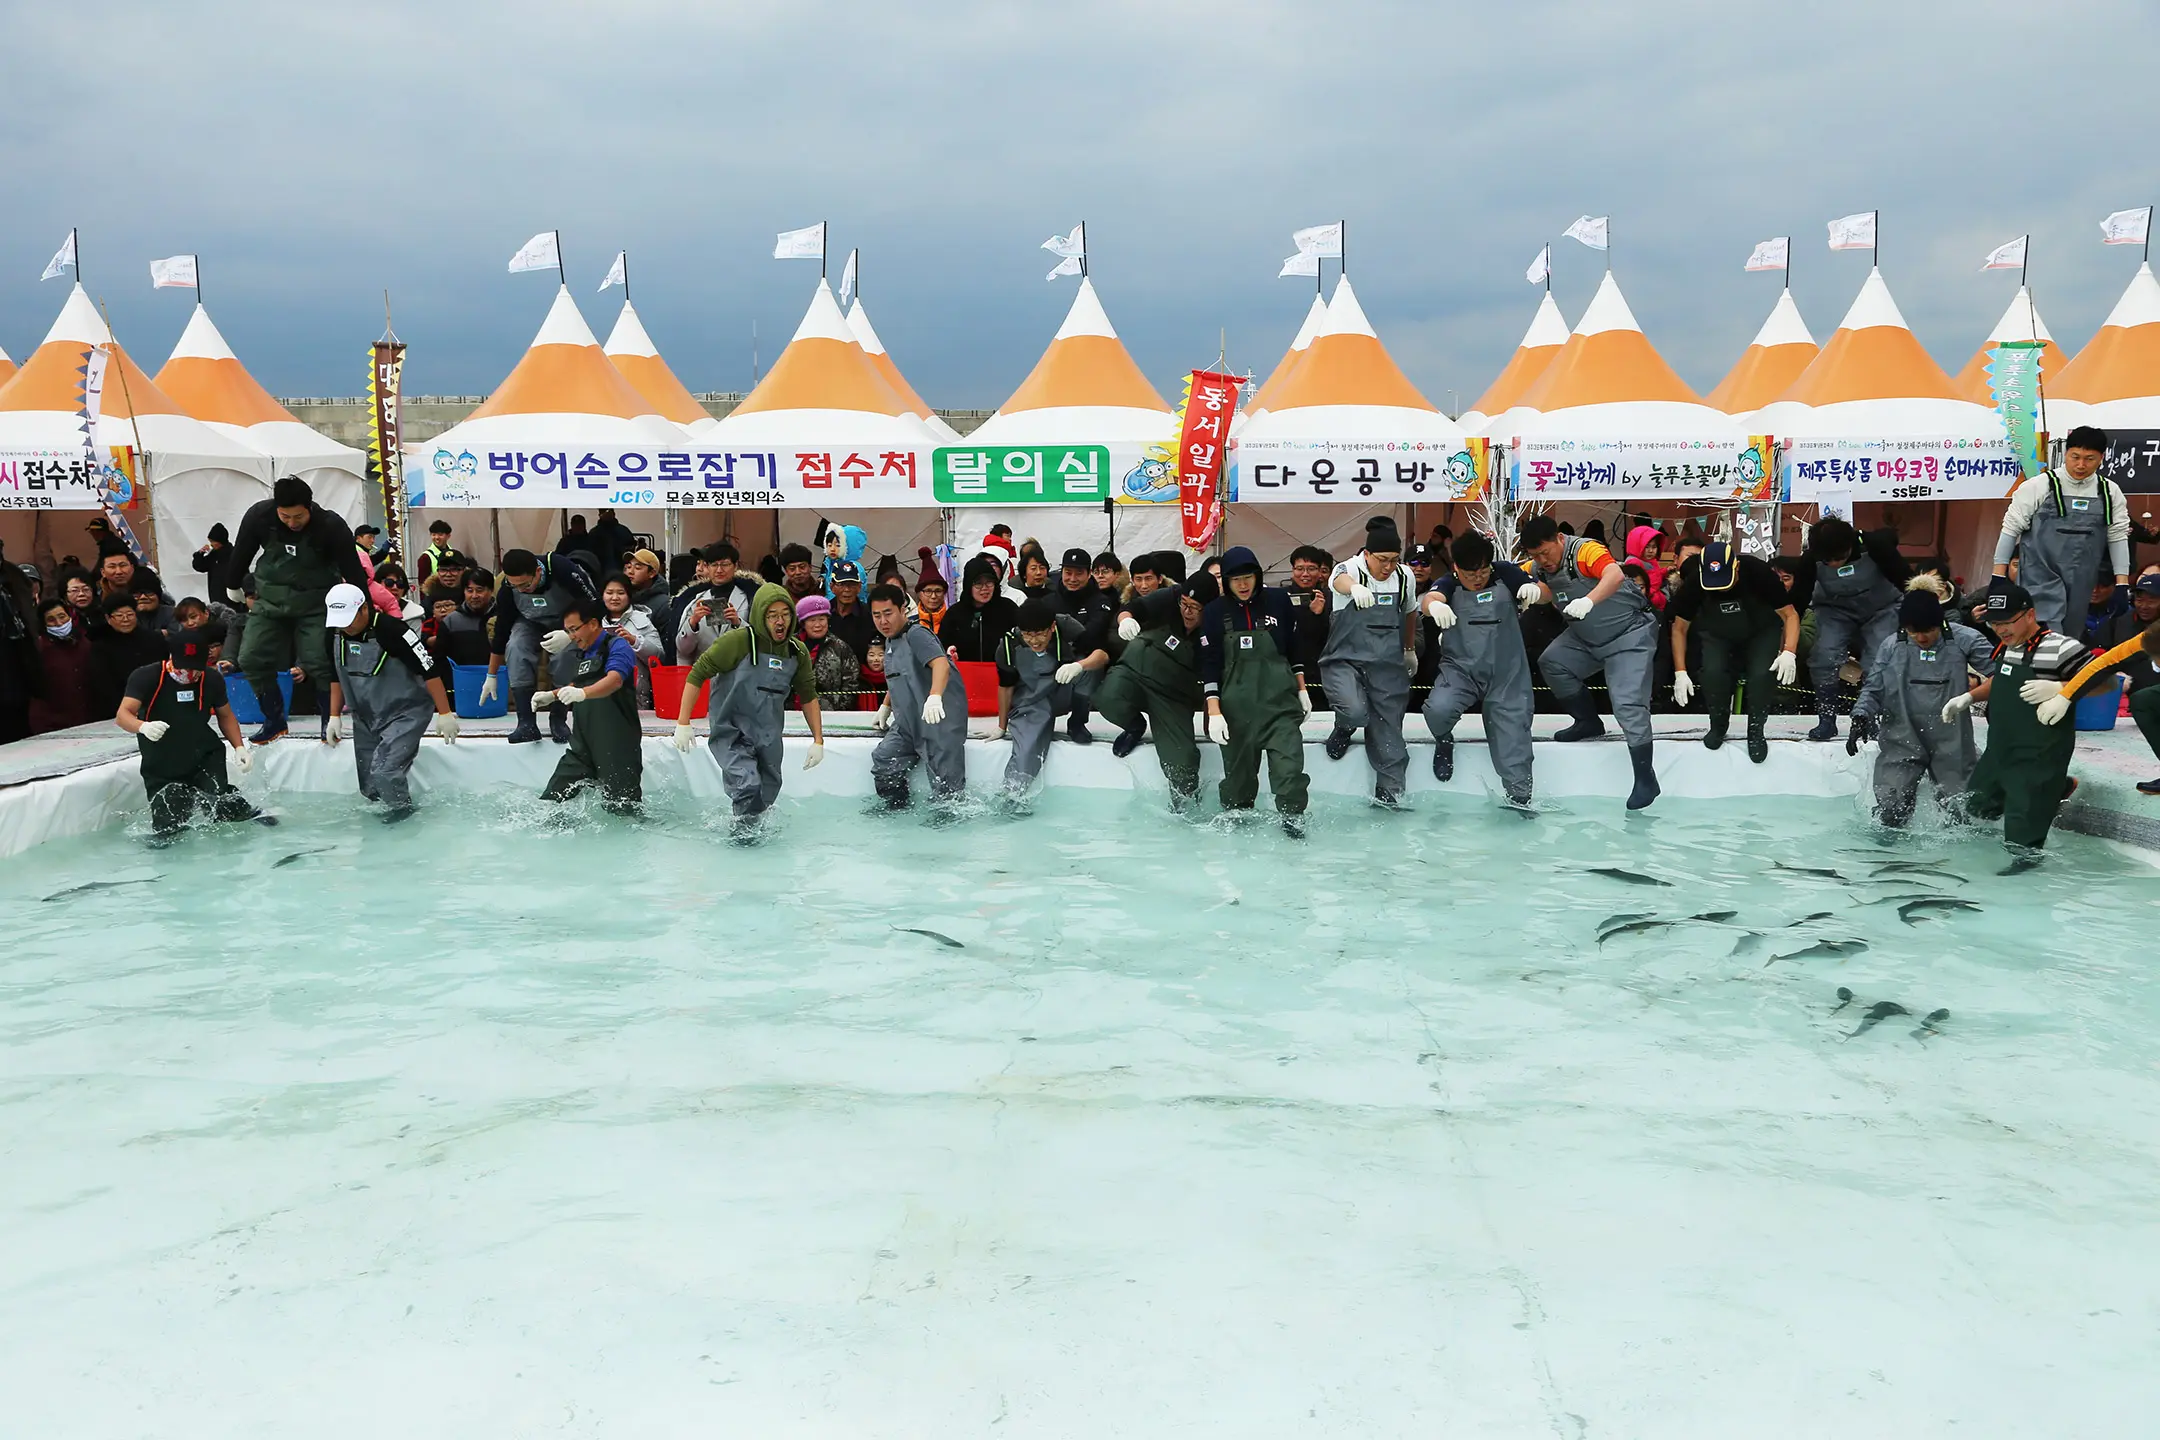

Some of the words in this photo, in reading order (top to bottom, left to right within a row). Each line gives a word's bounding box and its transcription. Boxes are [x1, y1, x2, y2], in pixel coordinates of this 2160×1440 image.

[488, 452, 779, 490] 방어손으로잡기
[795, 451, 917, 489] 접수처
[1182, 385, 1229, 524] 동서일과리
[1797, 457, 1873, 483] 제주특산품
[1876, 456, 1939, 482] 마유크림
[1944, 456, 2023, 481] 손마사지체
[946, 451, 1099, 494] 탈의실
[1254, 458, 1435, 496] 다온공방
[1527, 460, 1616, 492] 꽃과함께
[1622, 470, 1642, 488] by
[1648, 463, 1731, 489] 늘푸른꽃방
[609, 491, 640, 504] JCI
[666, 491, 785, 505] 모슬포청년회의소
[1892, 485, 1932, 498] SS뷰티
